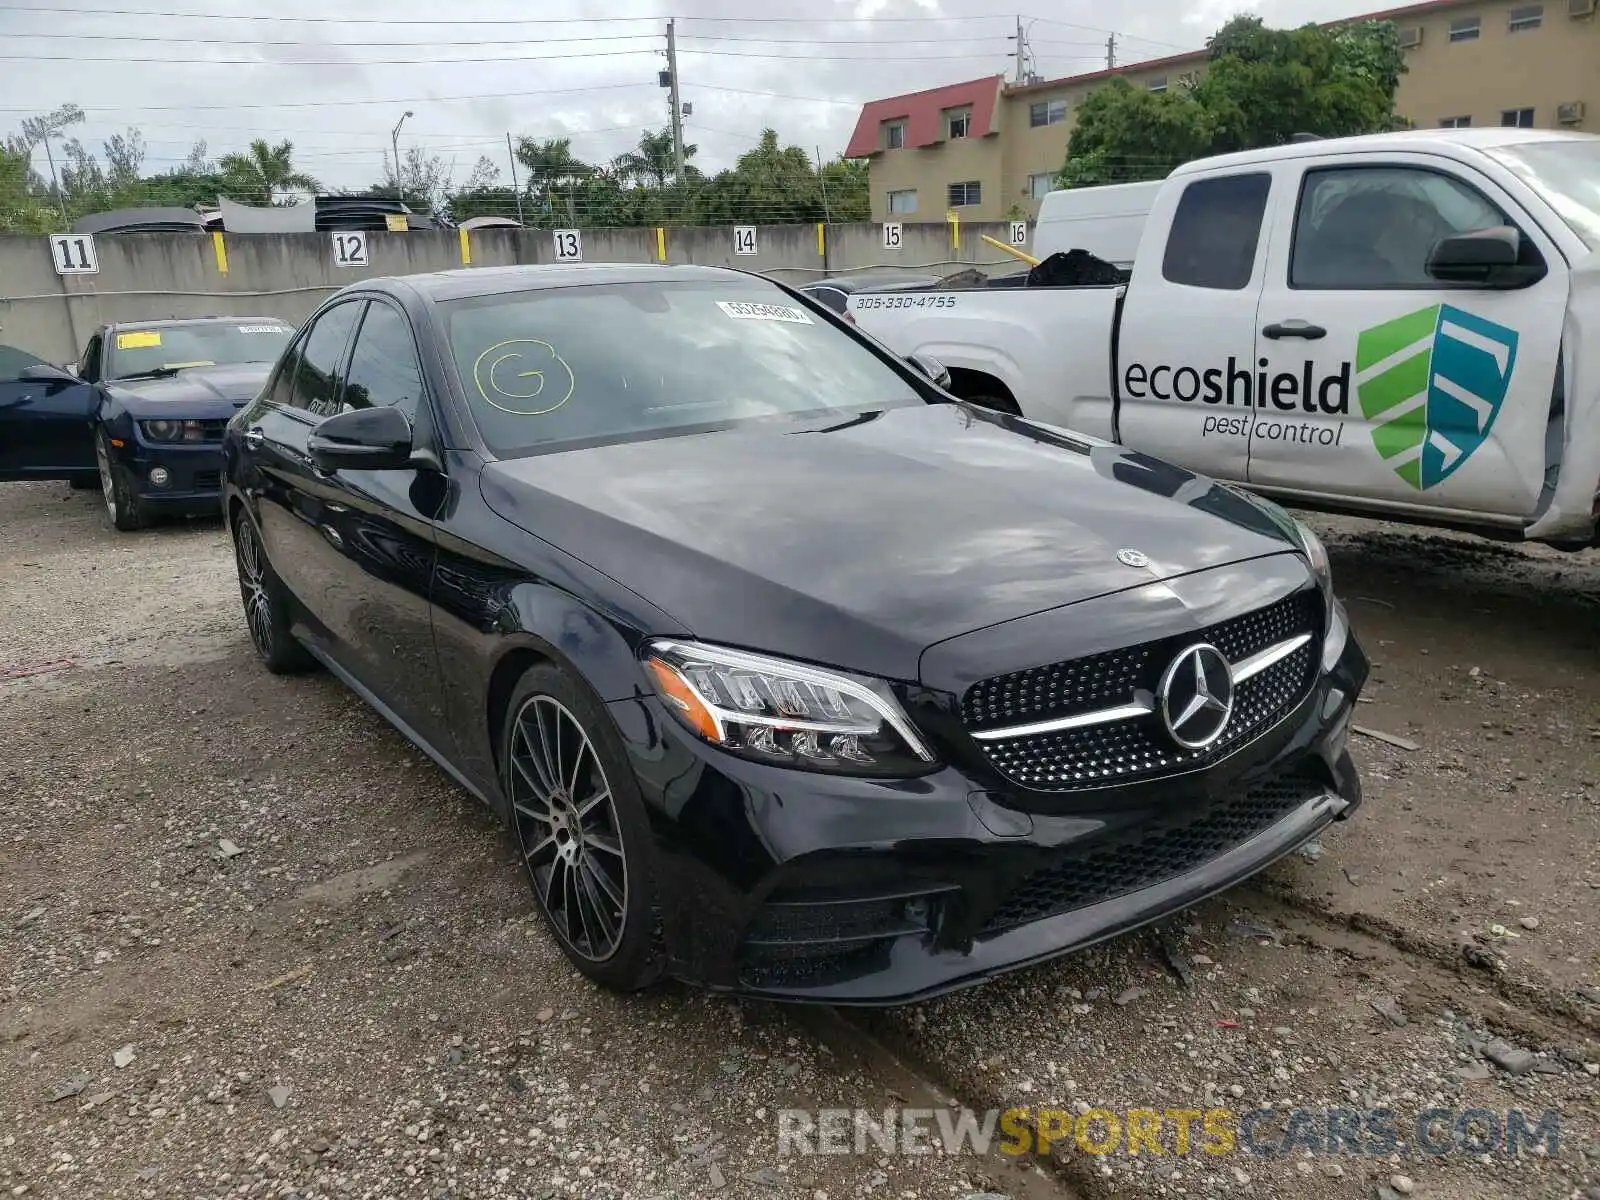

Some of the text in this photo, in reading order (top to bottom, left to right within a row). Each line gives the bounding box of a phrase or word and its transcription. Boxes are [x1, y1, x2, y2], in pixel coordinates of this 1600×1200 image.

[557, 234, 577, 257] 13
[737, 230, 754, 251] 14
[886, 226, 900, 246] 15
[1013, 225, 1025, 242] 16
[58, 240, 91, 268] 11
[336, 236, 363, 261] 12
[491, 353, 544, 398] G
[1125, 357, 1350, 414] ecoshield
[1203, 415, 1344, 446] pest control
